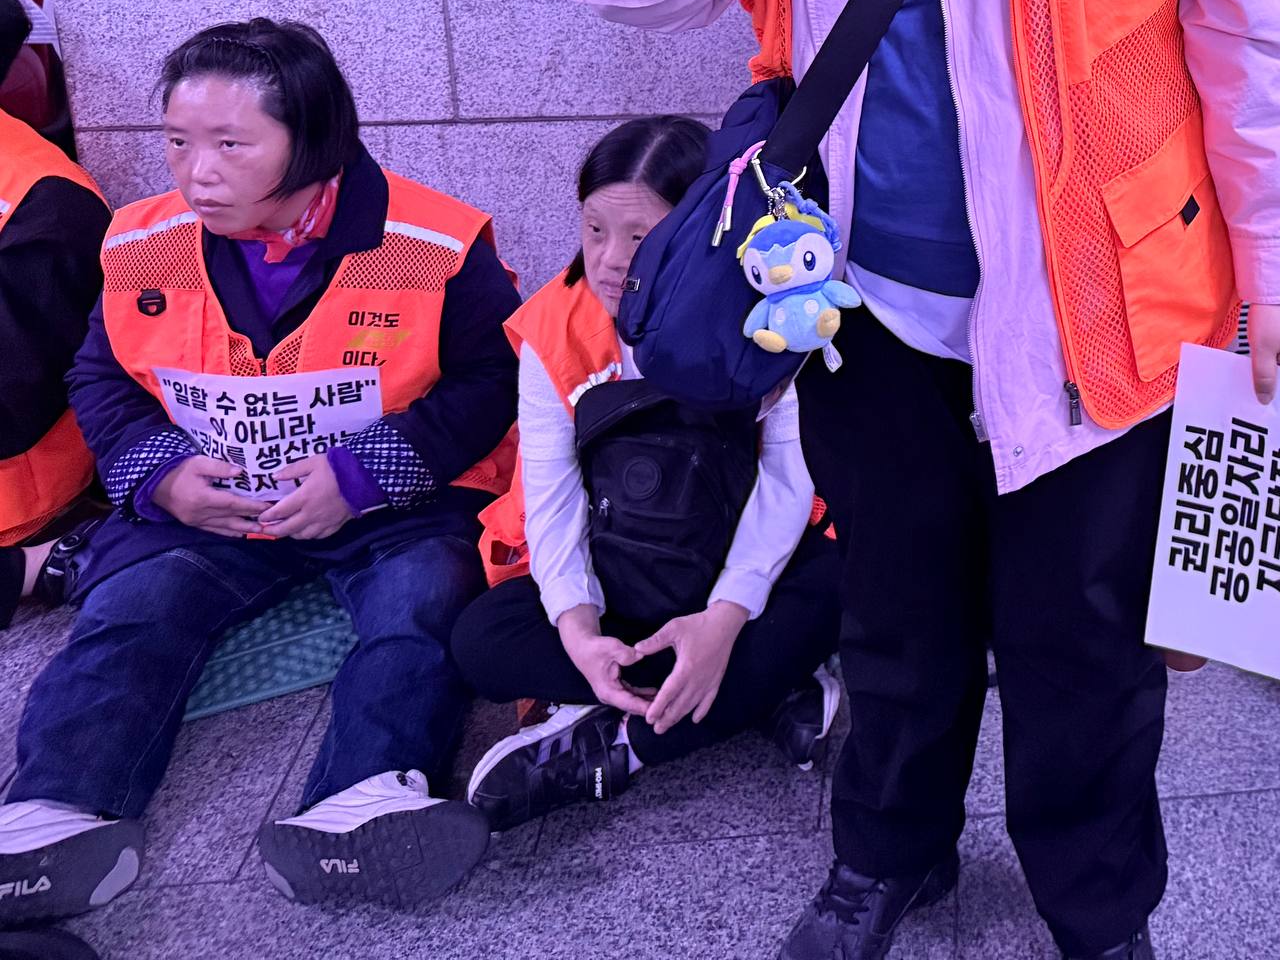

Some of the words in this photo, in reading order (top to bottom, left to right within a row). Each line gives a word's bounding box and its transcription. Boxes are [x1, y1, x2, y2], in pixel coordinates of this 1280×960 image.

[348, 310, 400, 328] 이것도
[162, 378, 208, 412] "일할
[215, 391, 237, 413] 수
[243, 390, 298, 417] 없는
[309, 379, 377, 411] 사람"
[209, 416, 228, 441] 이
[235, 413, 316, 445] 아니라
[1168, 425, 1224, 574] 권리중심
[1209, 417, 1268, 603] 공공일자리
[320, 858, 360, 875] FILA
[0, 875, 51, 899] FILA
